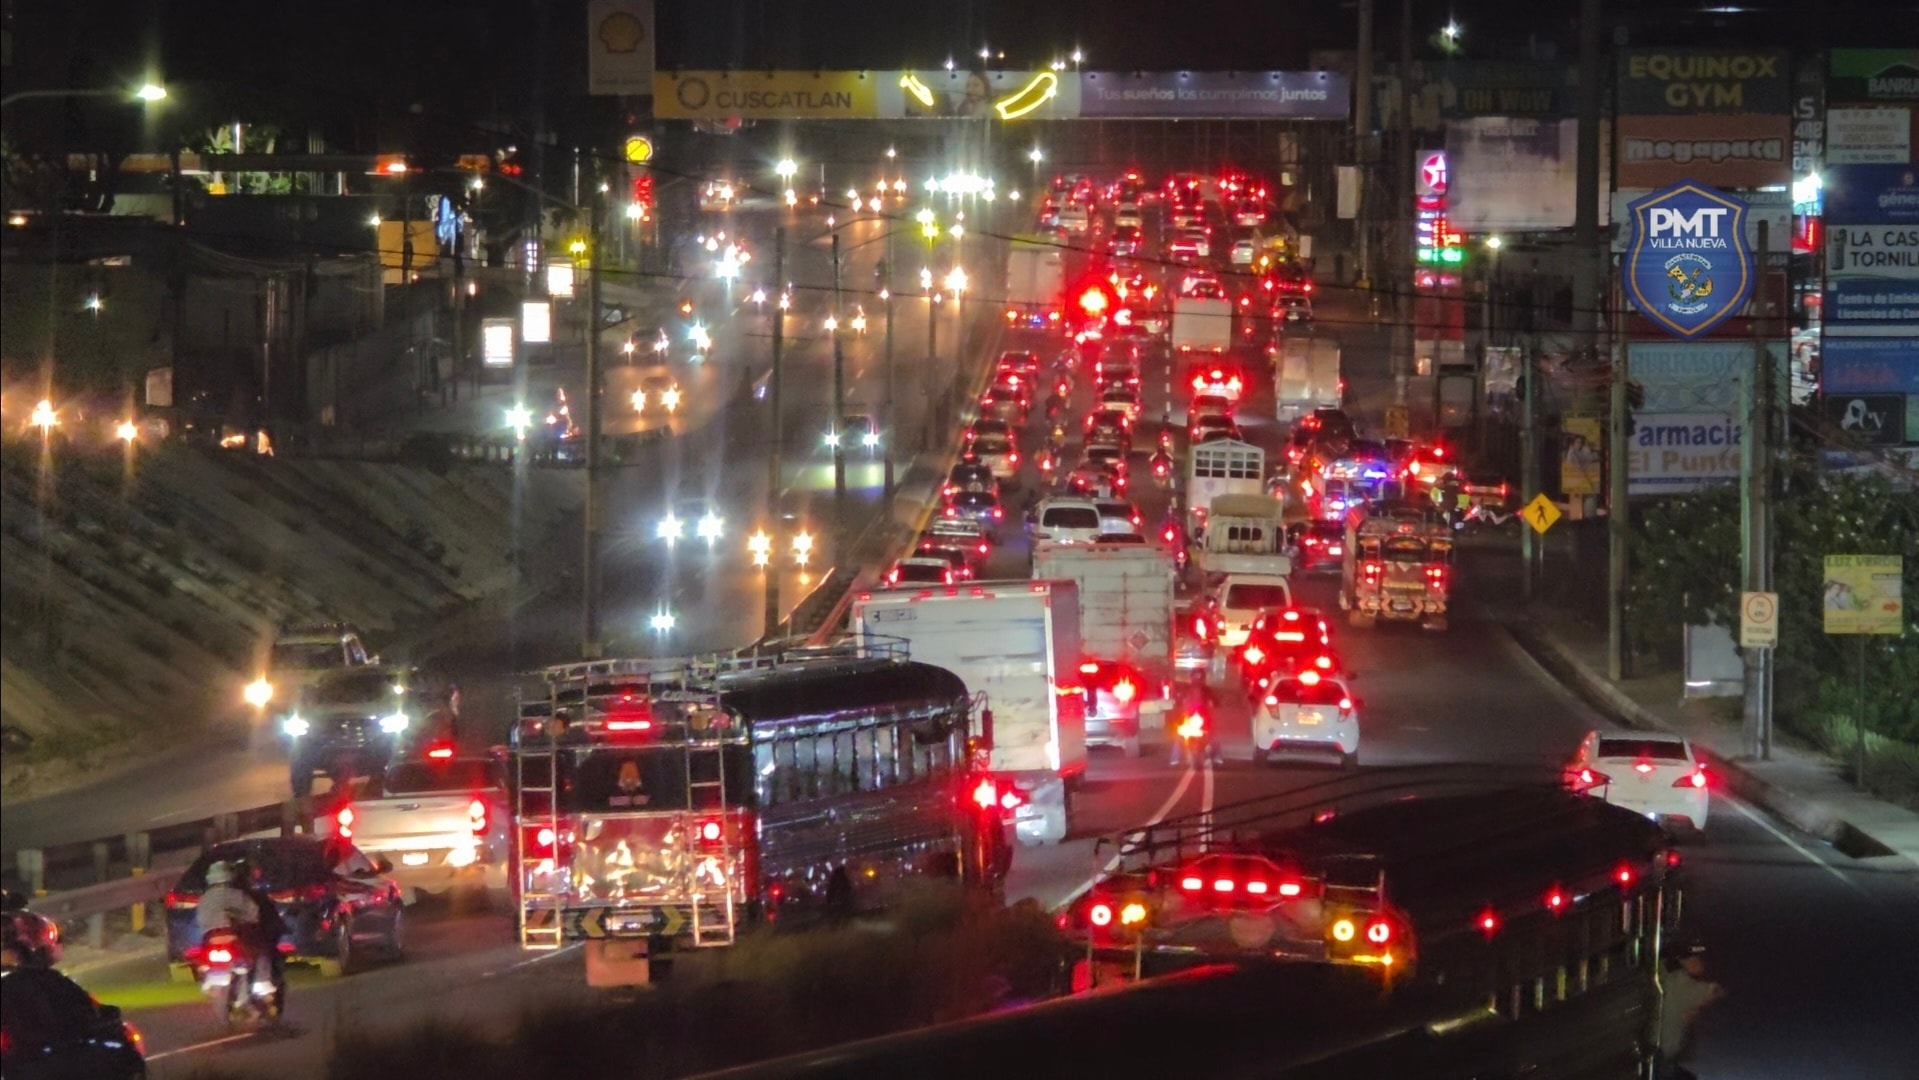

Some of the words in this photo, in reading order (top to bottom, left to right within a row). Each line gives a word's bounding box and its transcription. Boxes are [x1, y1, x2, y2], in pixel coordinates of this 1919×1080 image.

[1629, 55, 1777, 79] EQUINOX
[717, 91, 851, 109] CUSCATLAN
[1098, 88, 1121, 101] Tus
[1123, 87, 1175, 101] sueños
[1178, 87, 1197, 101] los
[1200, 88, 1278, 104] cumplimos
[1280, 87, 1327, 103] juntos
[1665, 83, 1743, 107] GYM
[1852, 231, 1873, 246] LA
[1883, 231, 1919, 246] CAS
